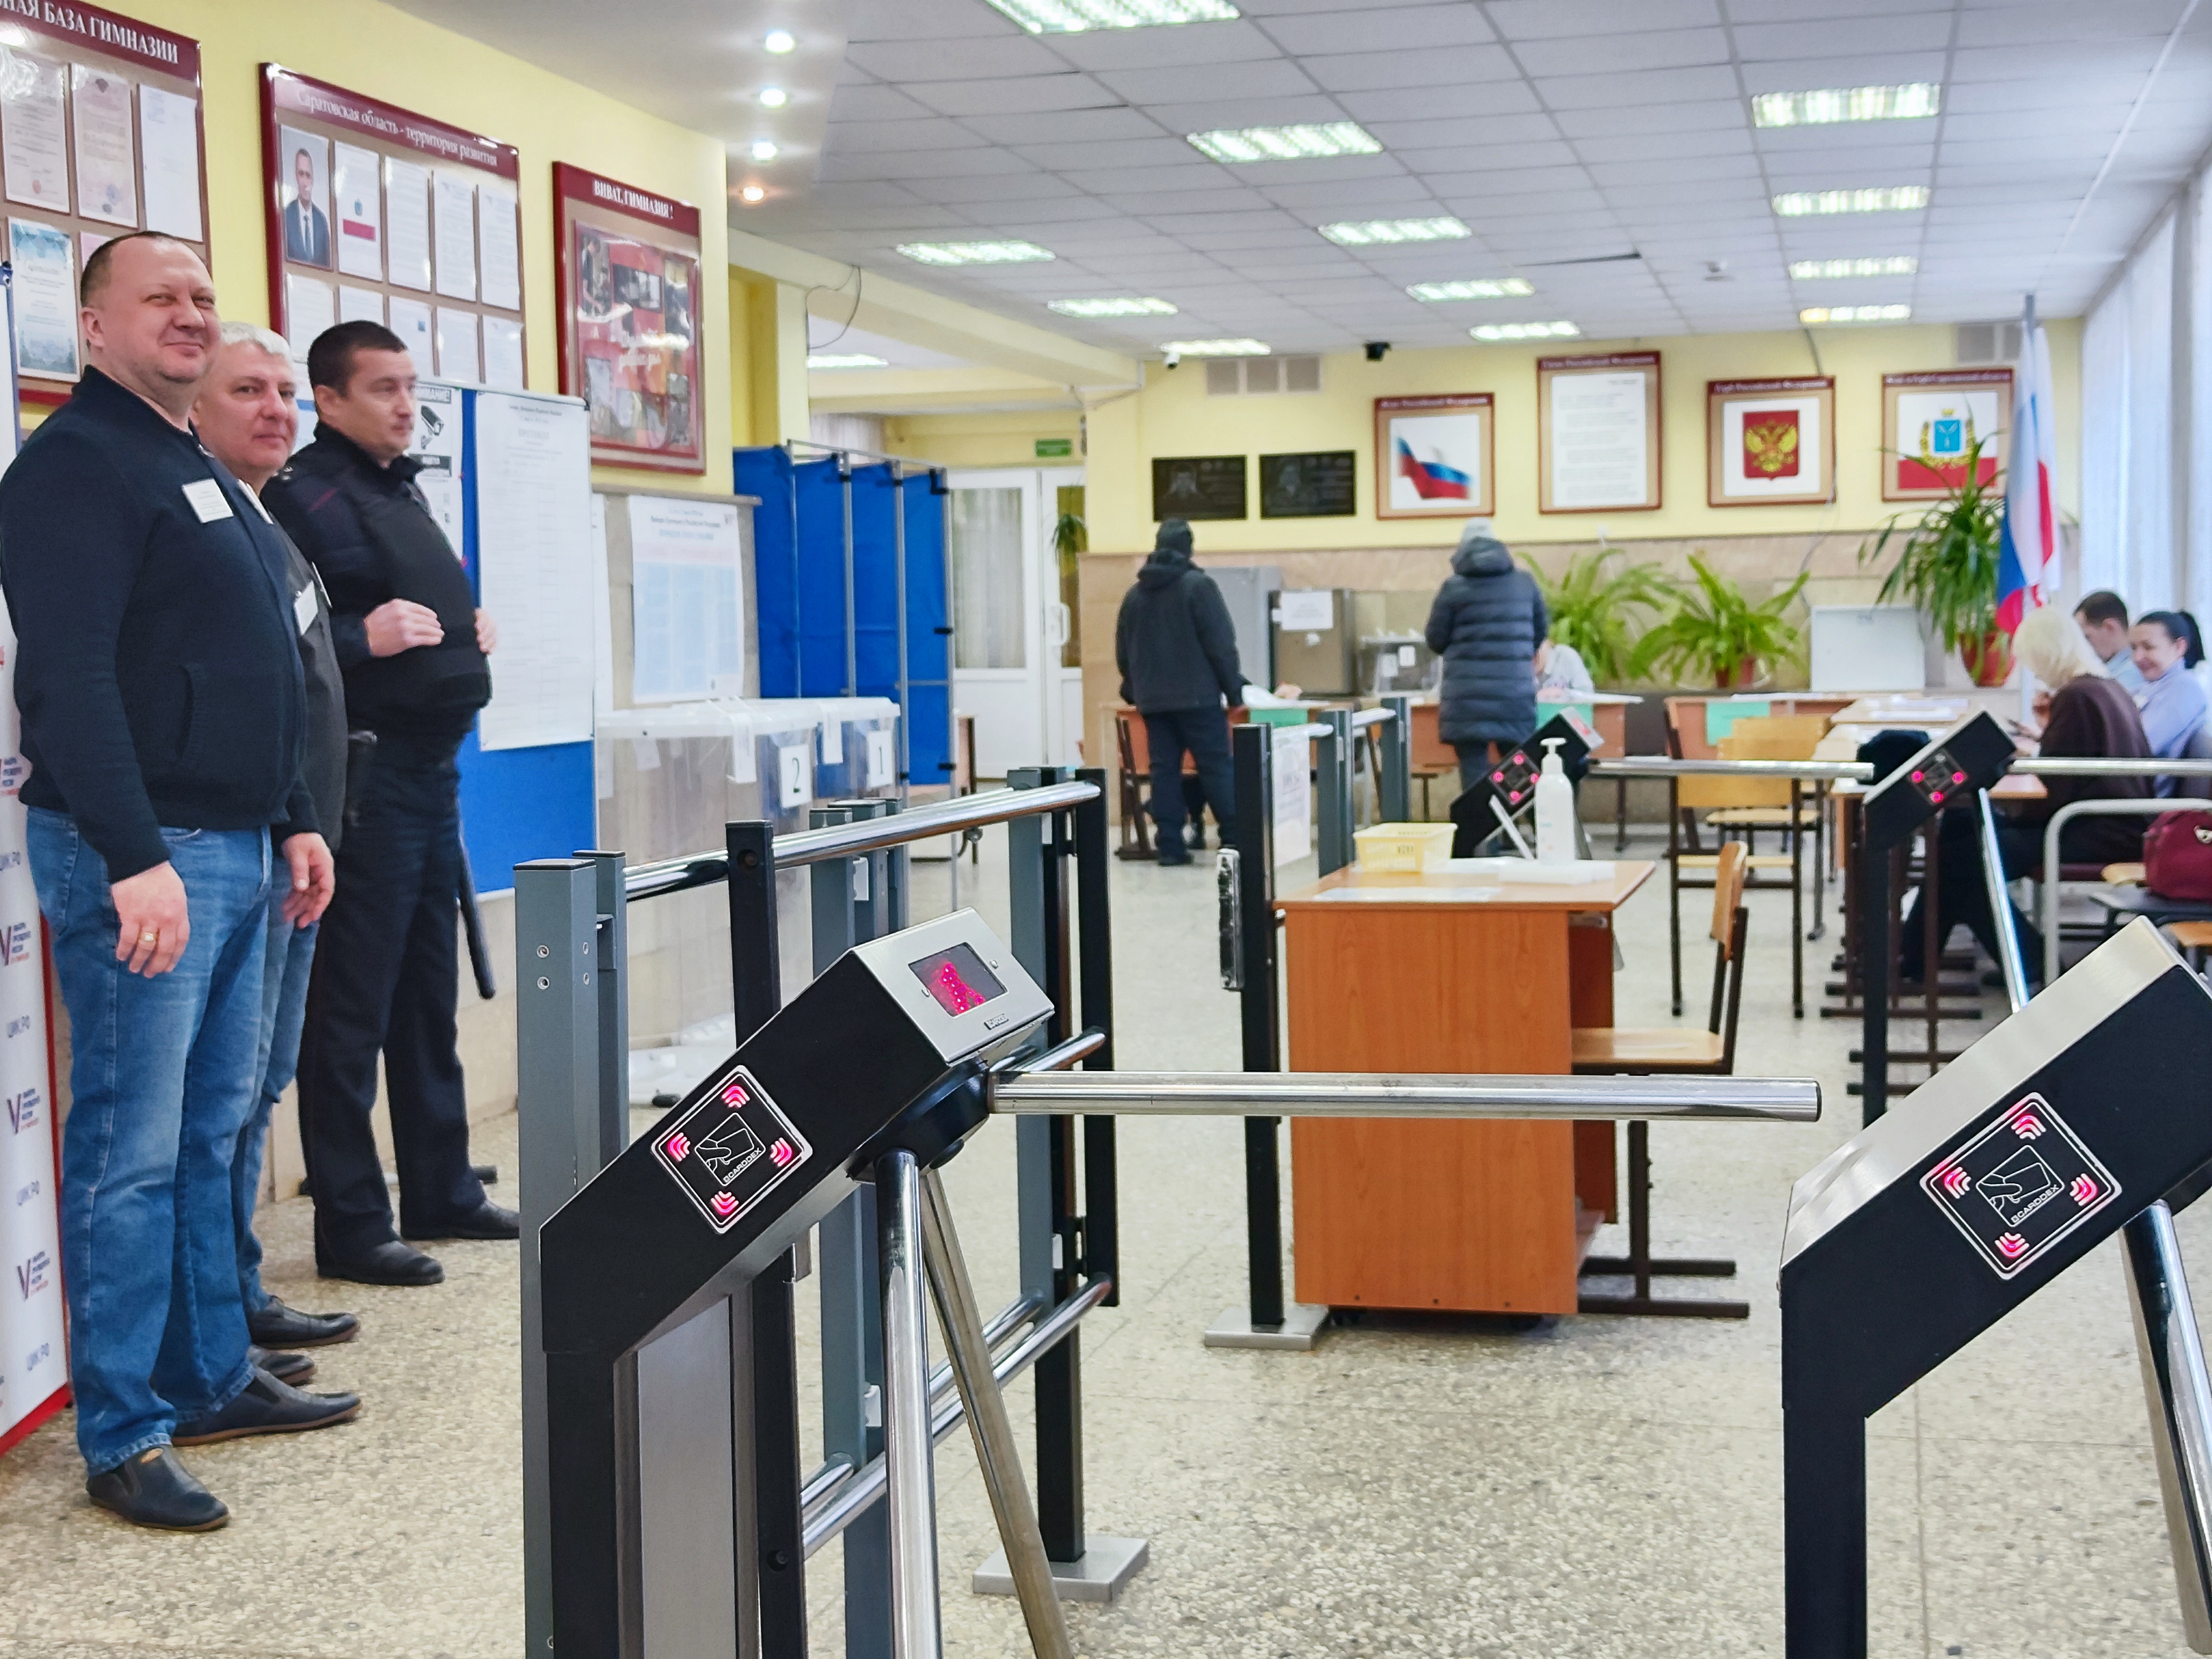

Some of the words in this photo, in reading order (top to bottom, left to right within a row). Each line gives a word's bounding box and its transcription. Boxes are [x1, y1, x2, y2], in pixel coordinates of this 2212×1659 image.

[45, 2, 87, 35] БАЗА
[90, 16, 179, 64] ГИМНАЗИИ
[298, 87, 360, 122] Саратовская
[362, 109, 399, 134] область
[406, 126, 458, 154] территория
[460, 144, 498, 166] развития
[792, 757, 801, 794] 2
[878, 746, 884, 775] 1
[727, 1147, 762, 1178] CARDDEX
[2017, 1183, 2060, 1218] CARDDEX
